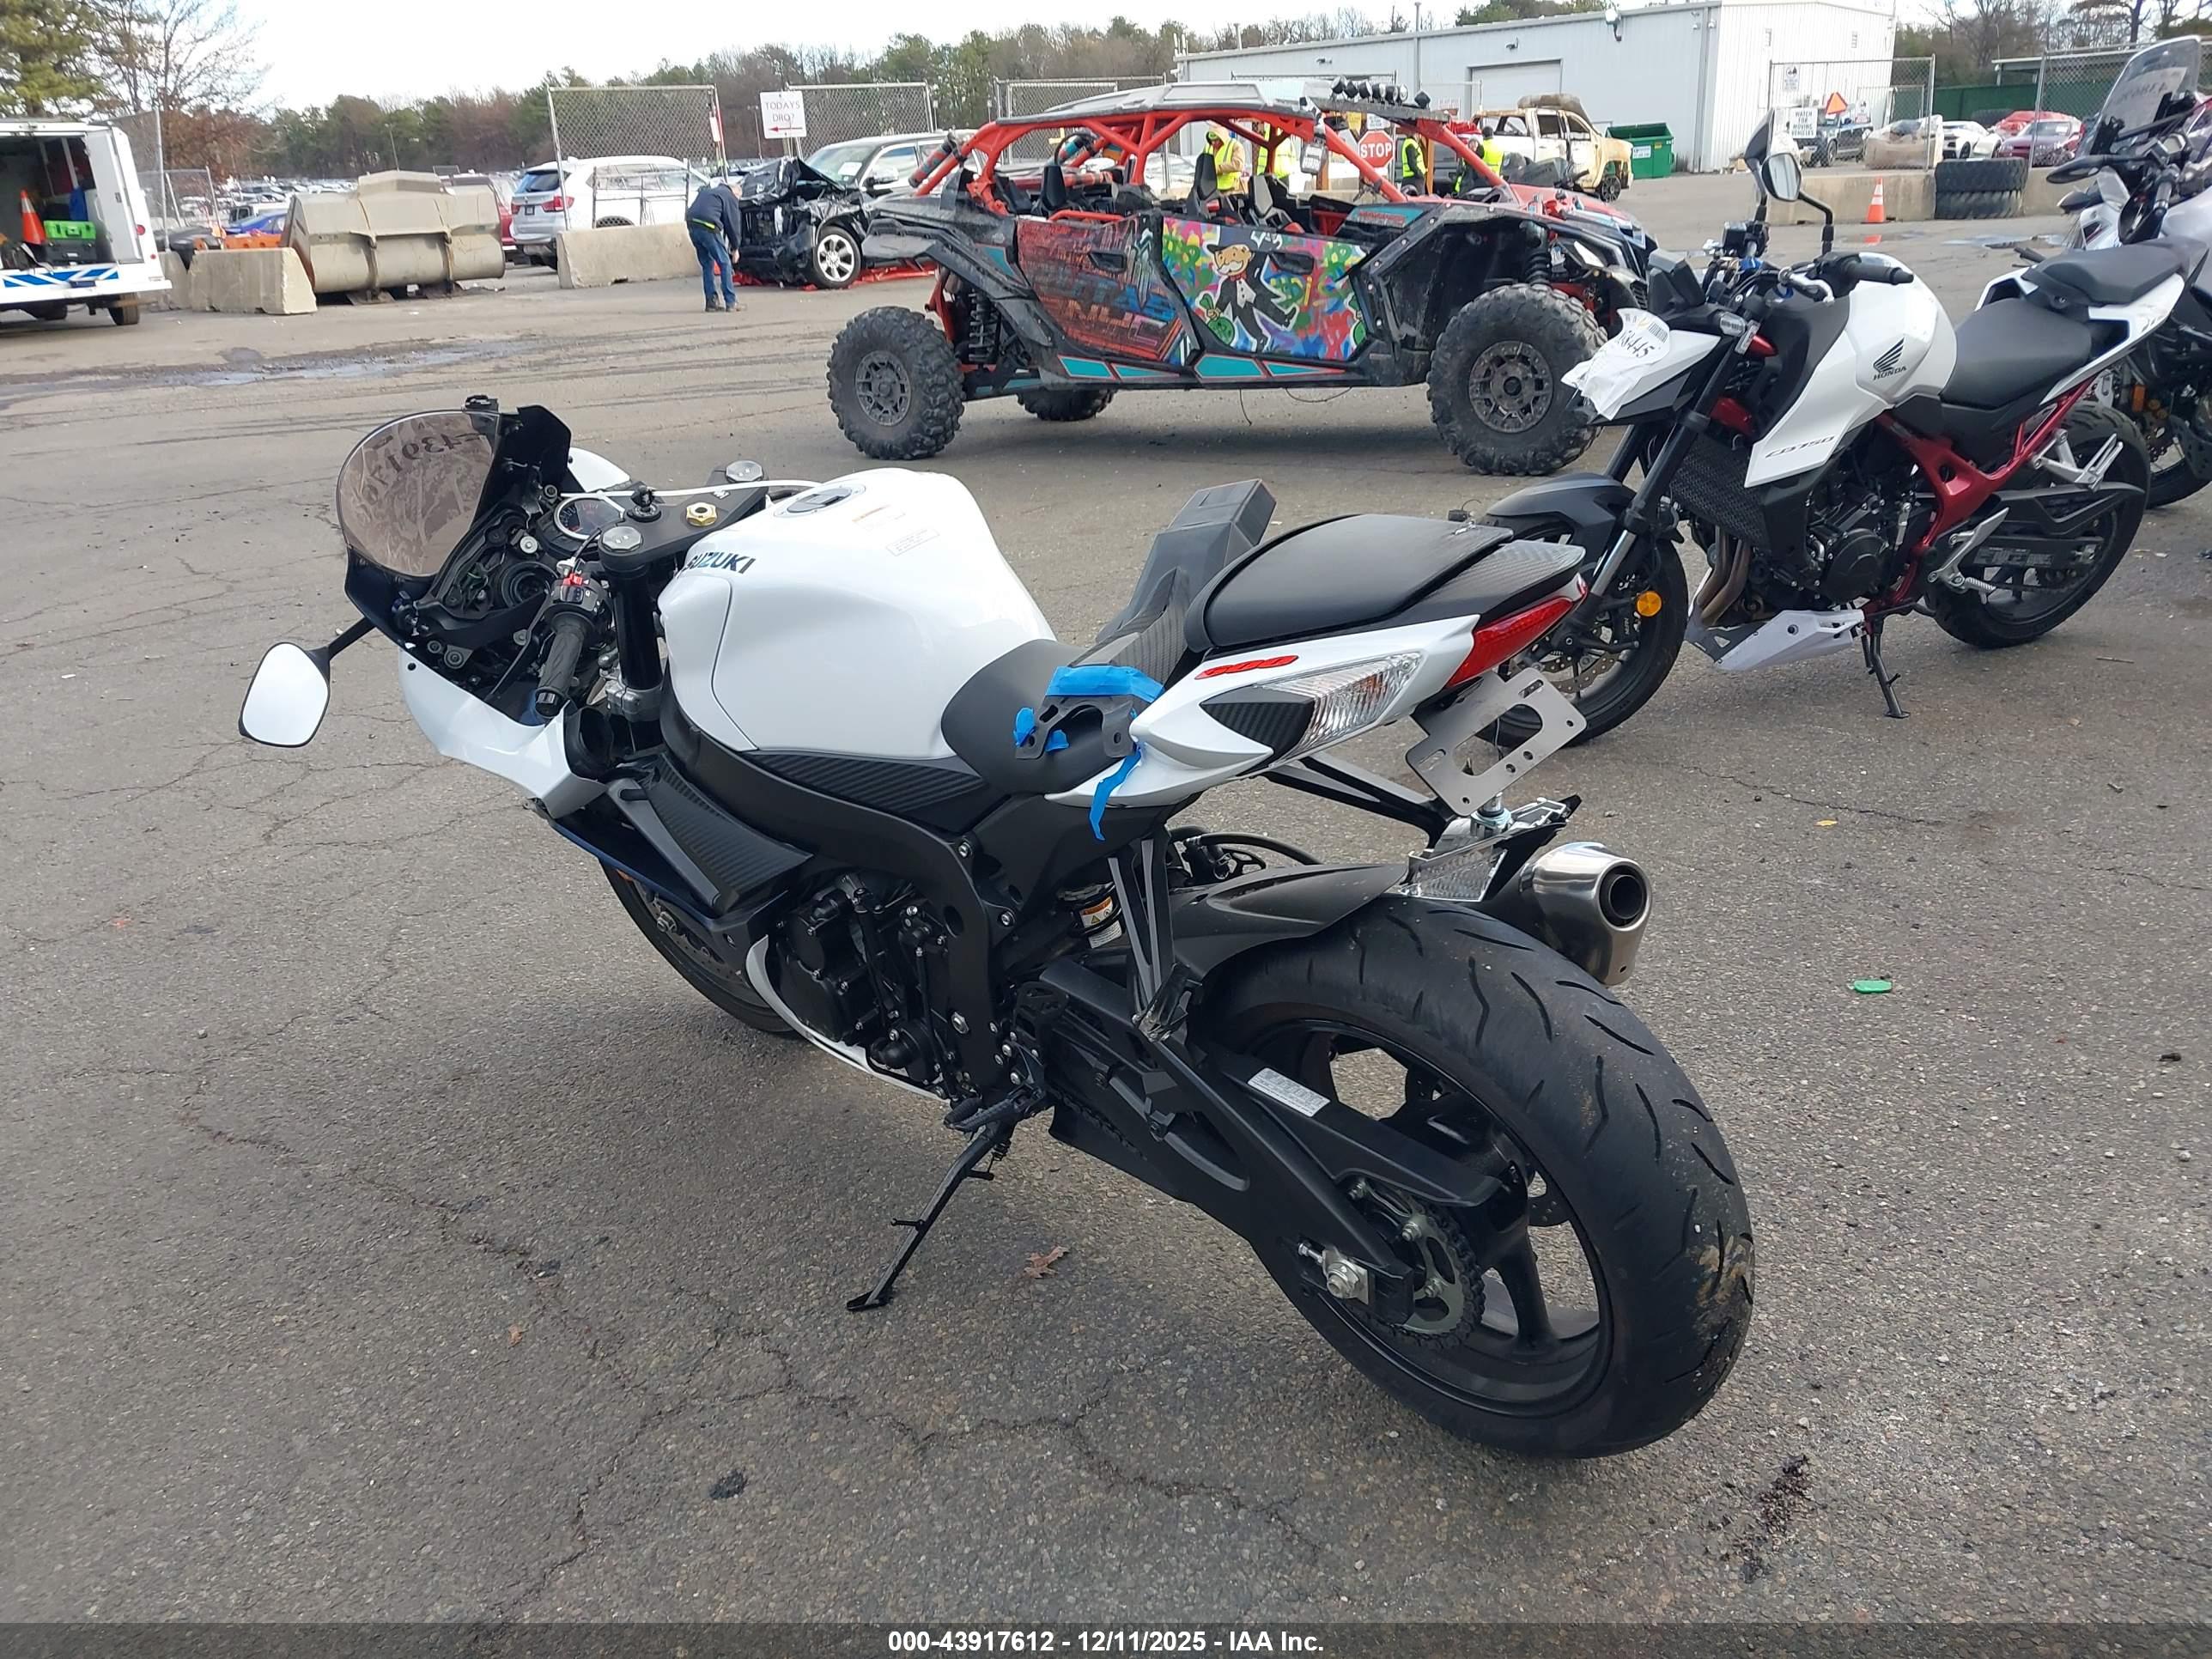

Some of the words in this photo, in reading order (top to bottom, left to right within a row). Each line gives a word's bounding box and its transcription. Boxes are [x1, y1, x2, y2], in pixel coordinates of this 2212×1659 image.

[765, 101, 800, 110] TODAYS
[1360, 143, 1392, 159] STOP
[1873, 366, 1907, 380] HONDA
[683, 551, 757, 574] SUZUKI
